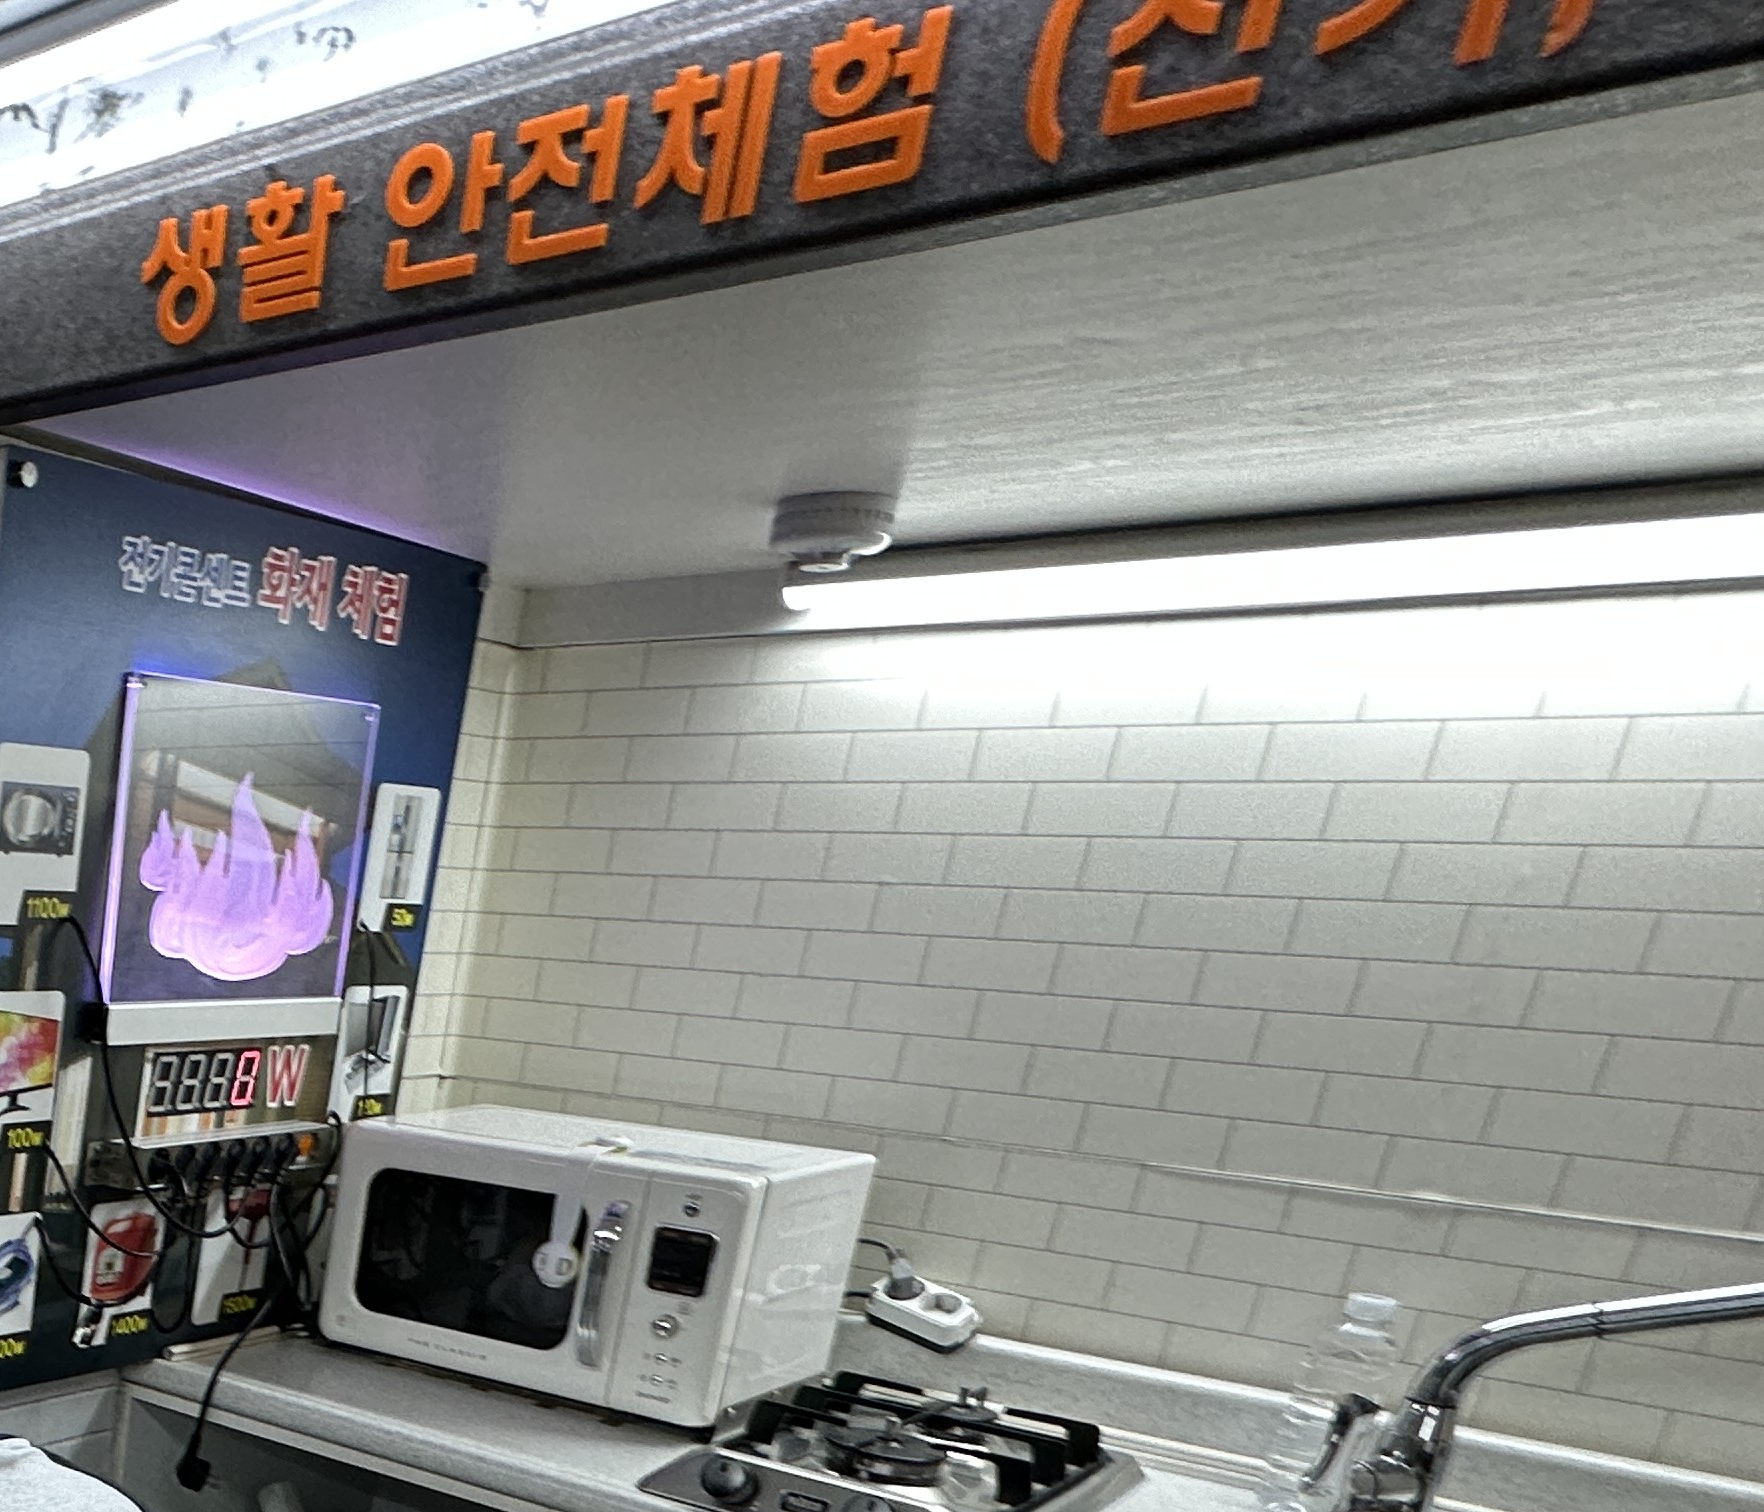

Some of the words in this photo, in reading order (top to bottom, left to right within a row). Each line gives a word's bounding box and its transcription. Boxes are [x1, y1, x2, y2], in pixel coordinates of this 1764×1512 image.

[142, 174, 345, 345] 생활
[383, 4, 954, 292] 안전체험
[257, 547, 336, 631] 화재
[336, 564, 410, 646] 체험
